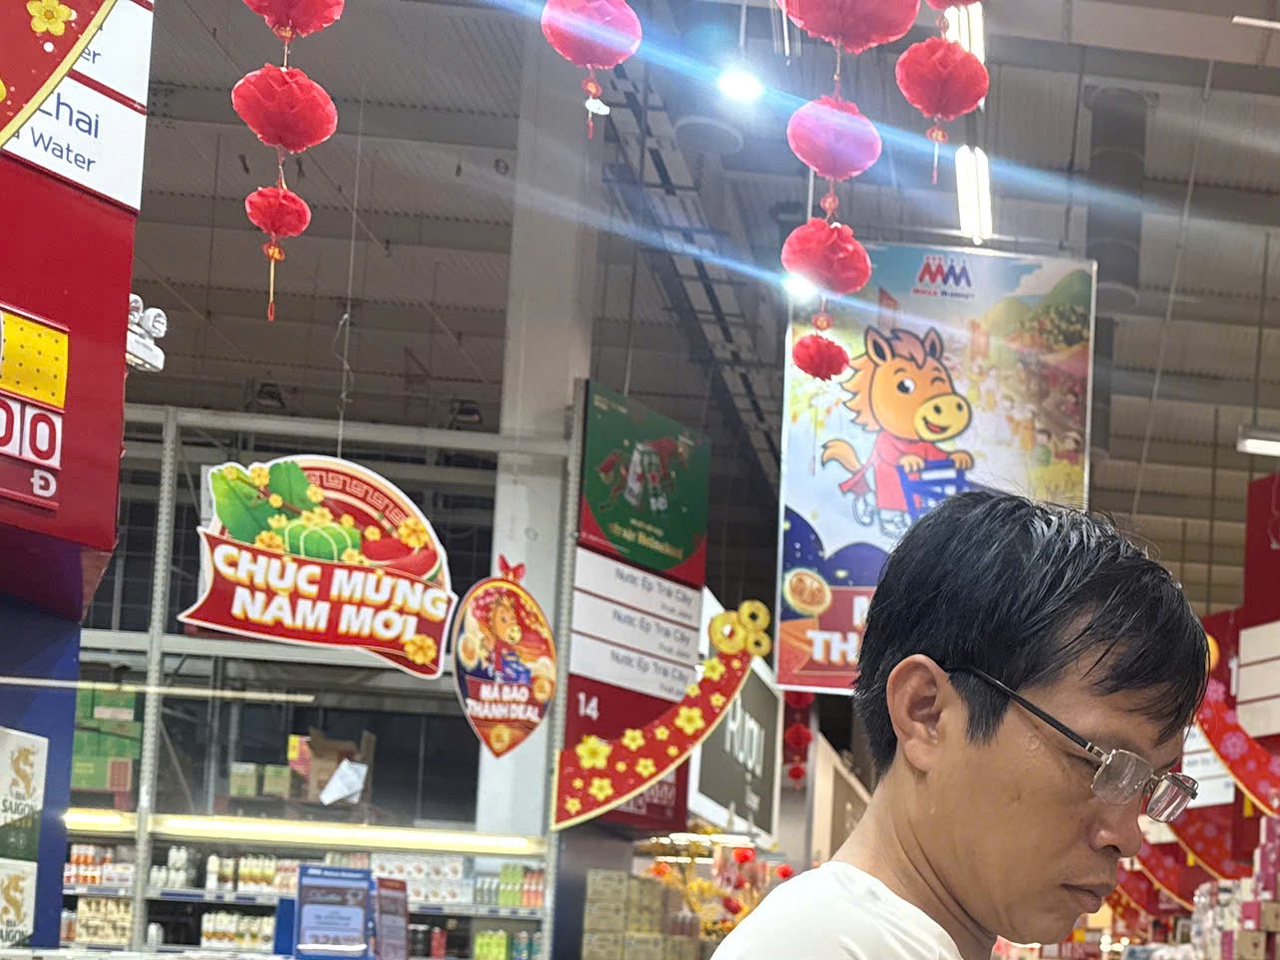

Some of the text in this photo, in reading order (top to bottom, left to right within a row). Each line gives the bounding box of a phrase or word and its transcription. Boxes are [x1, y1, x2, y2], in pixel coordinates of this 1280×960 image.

[38, 91, 101, 139] hai
[30, 126, 97, 172] Water
[577, 691, 599, 721] 14
[0, 927, 27, 943] AIGON
